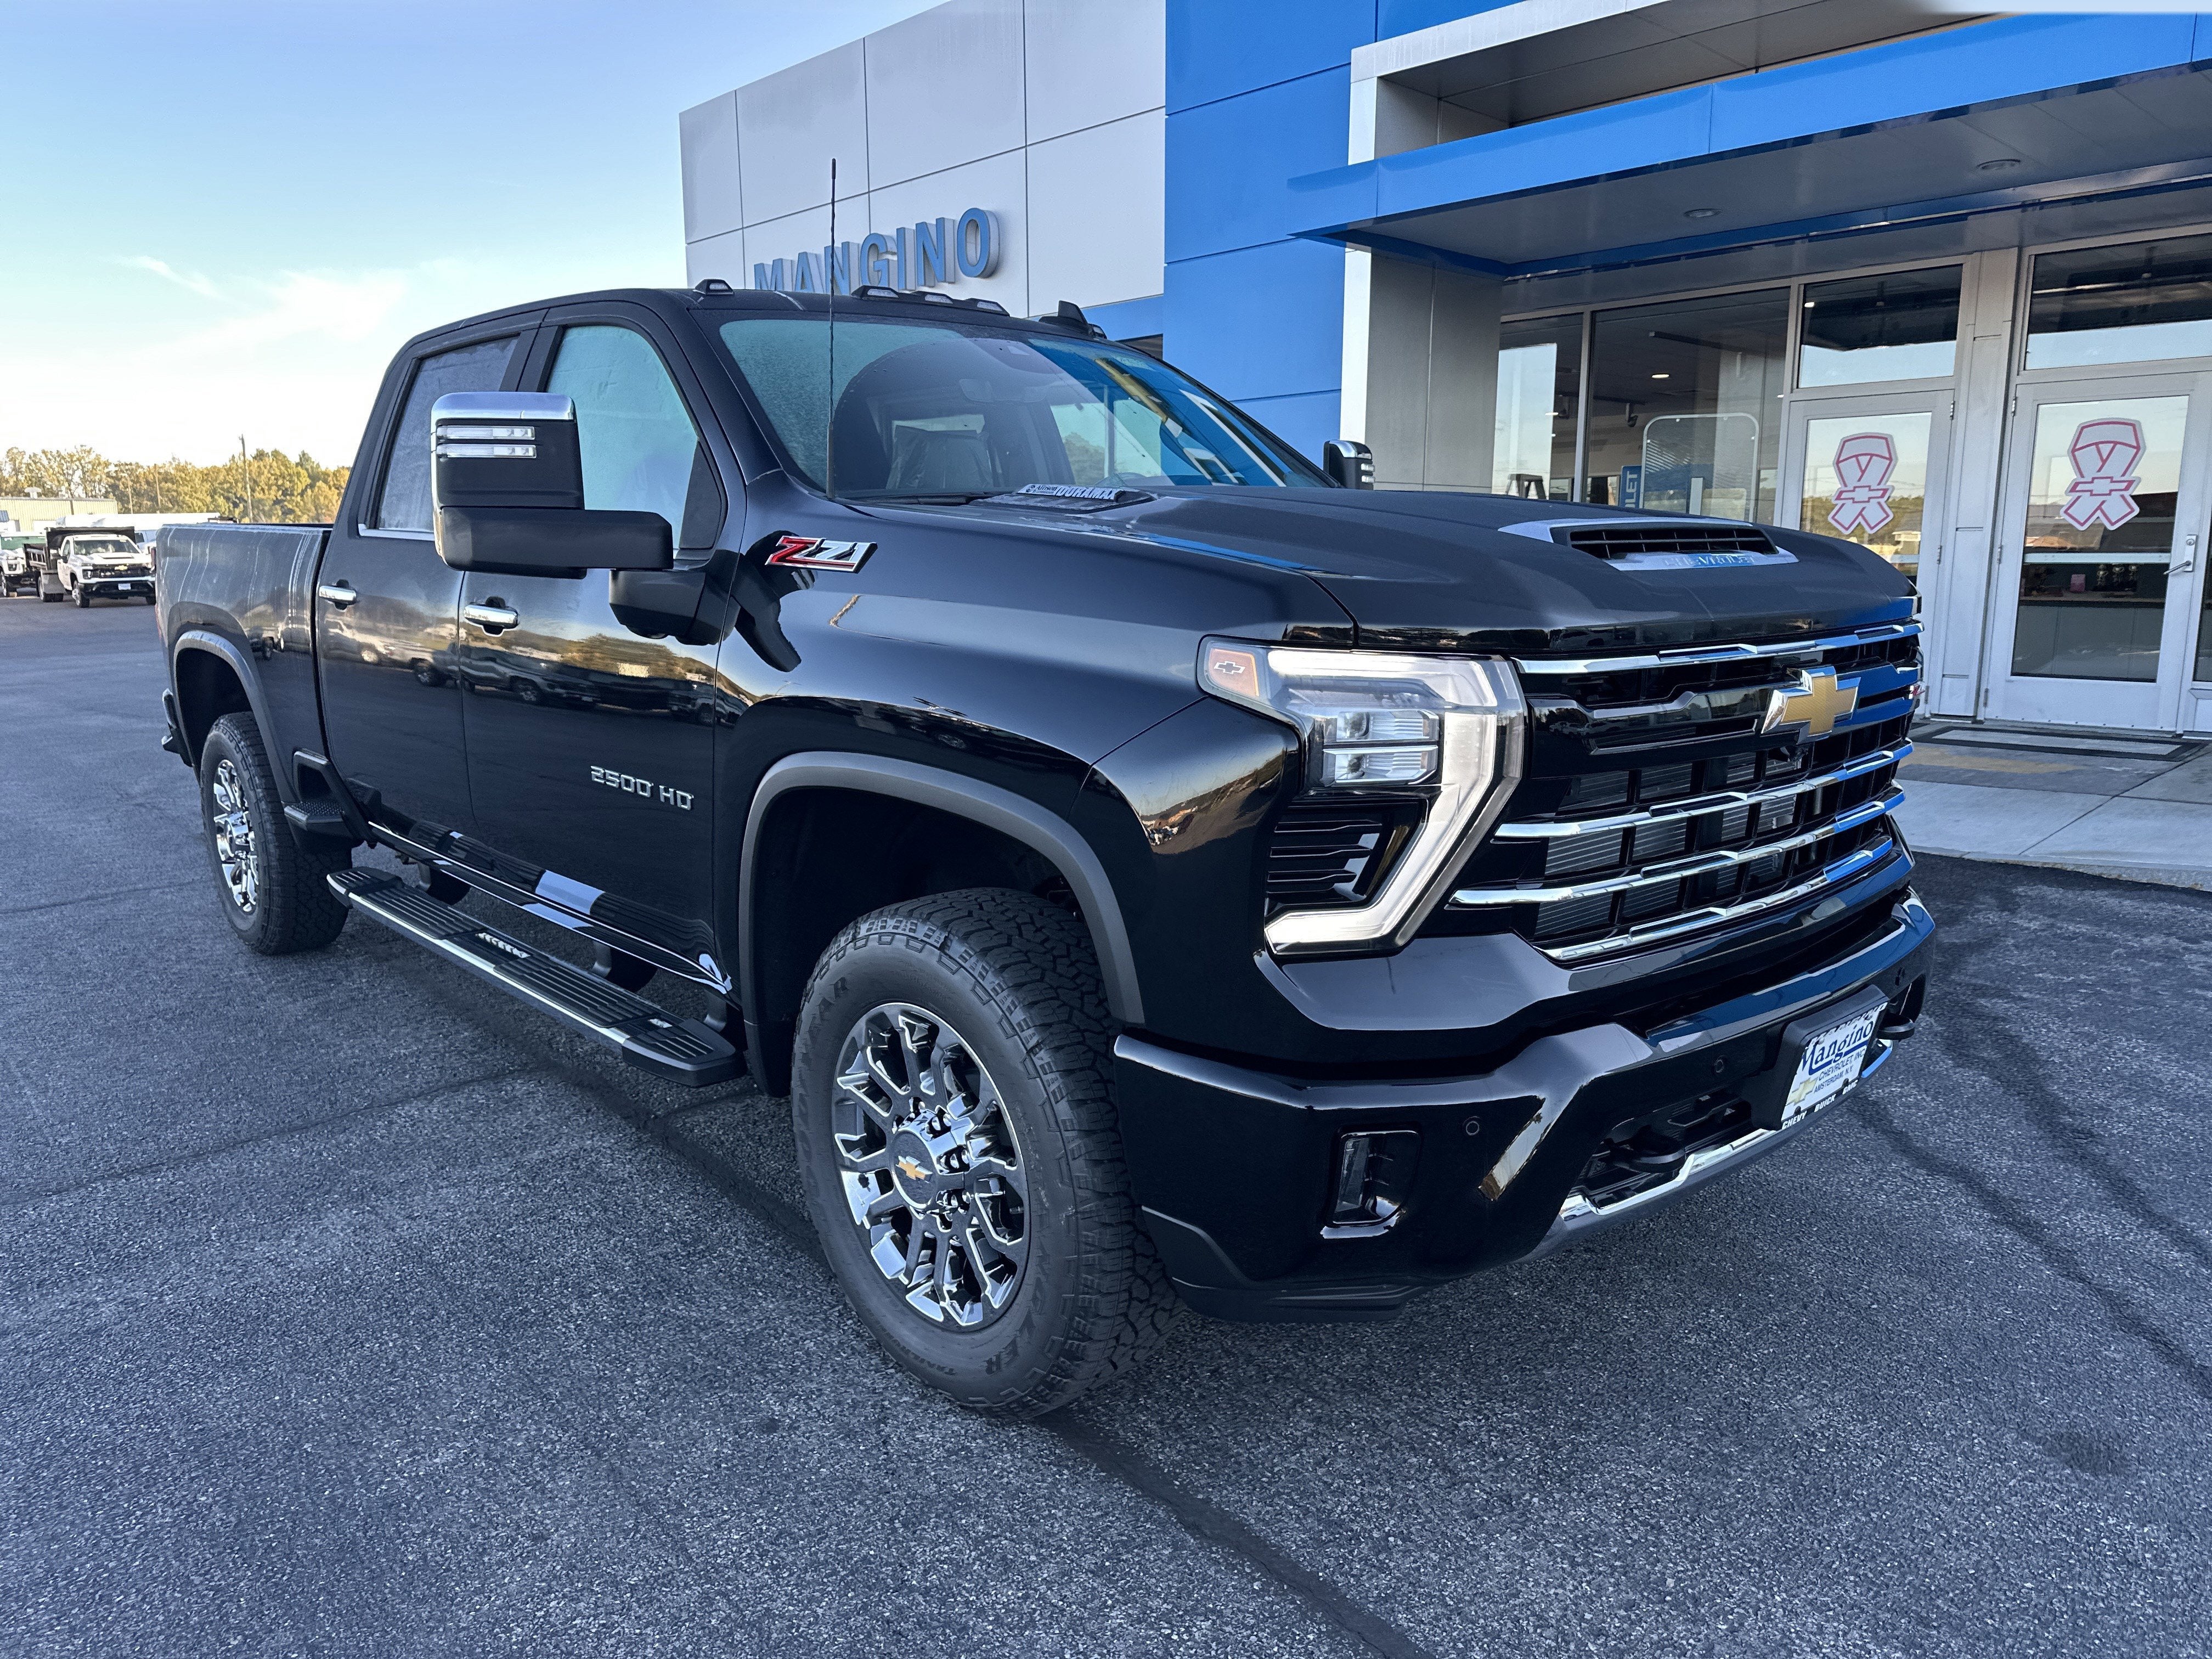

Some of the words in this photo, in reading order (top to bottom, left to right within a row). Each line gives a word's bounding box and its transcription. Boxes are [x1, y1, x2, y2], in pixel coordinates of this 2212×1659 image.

[754, 207, 996, 295] MANGINO
[1056, 486, 1120, 500] DURAMAX
[765, 535, 877, 574] Z71
[591, 765, 654, 798] 2500
[659, 785, 694, 811] HD
[1802, 1020, 1874, 1075] Mangino
[1782, 1110, 1807, 1130] CHEVY
[1814, 1093, 1837, 1113] BUICK
[1842, 1079, 1858, 1095] GMC
